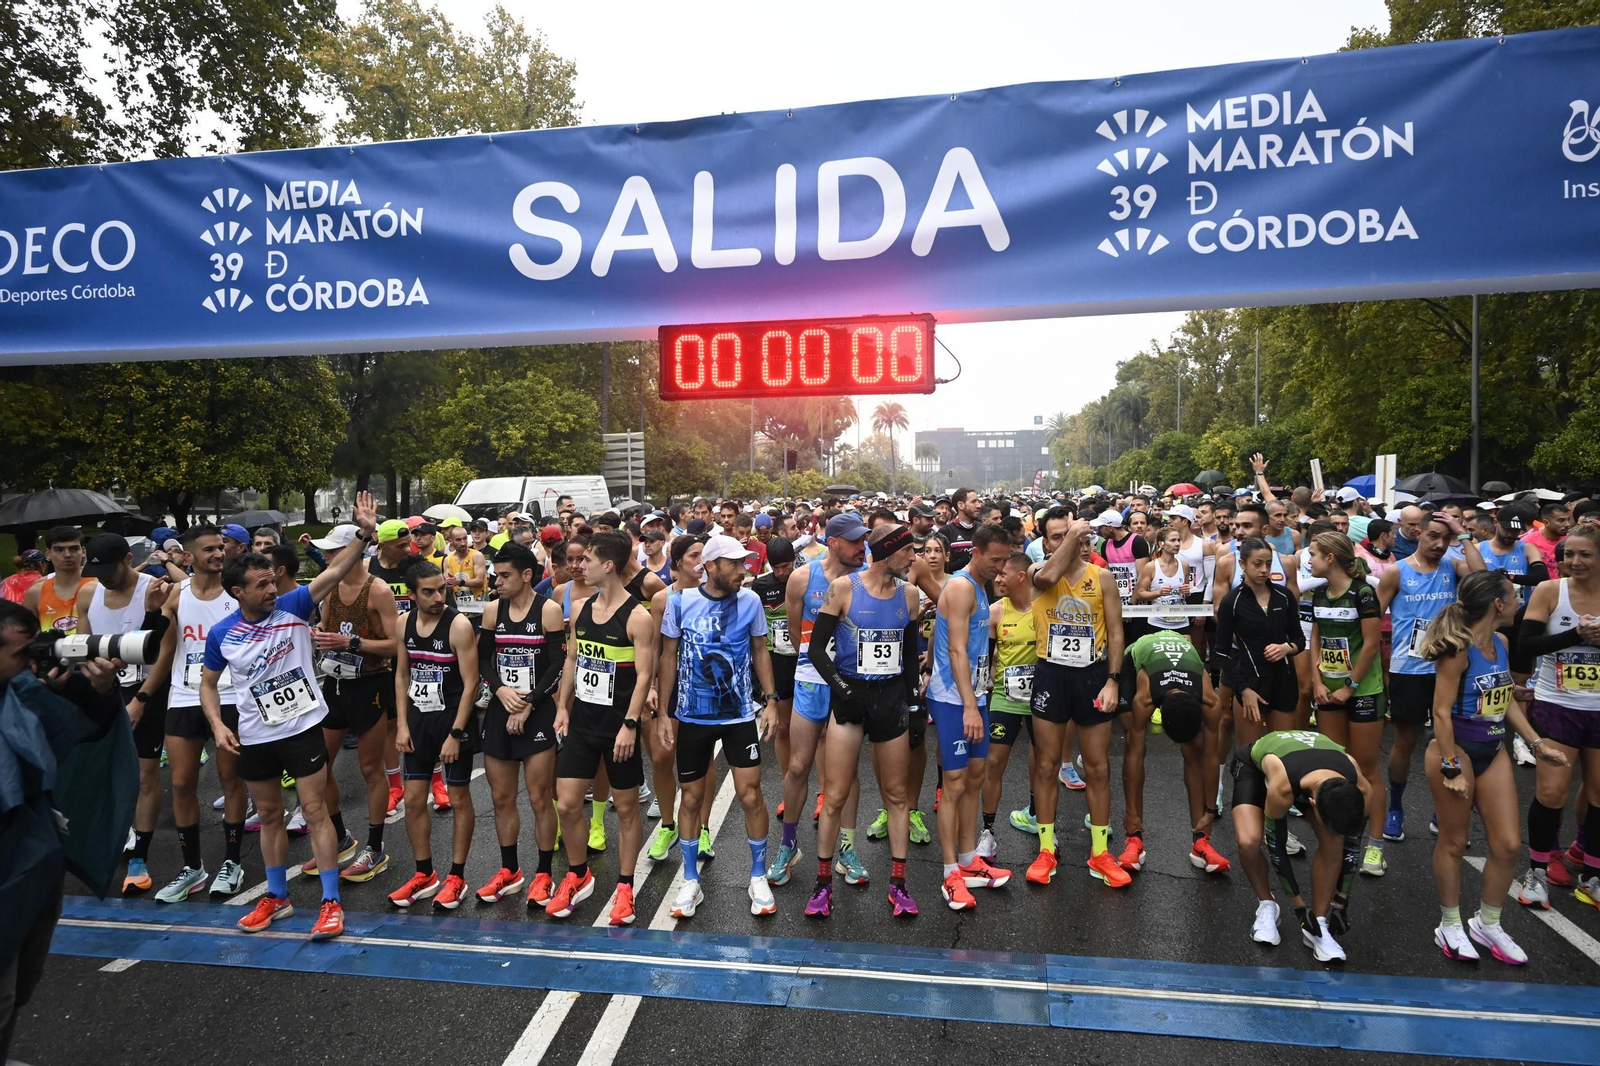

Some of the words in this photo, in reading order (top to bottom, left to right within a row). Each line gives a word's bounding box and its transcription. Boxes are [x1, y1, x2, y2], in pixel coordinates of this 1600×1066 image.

[1186, 88, 1327, 133] MEDIA
[1187, 117, 1414, 174] MARATÓN
[265, 179, 361, 211] MEDIA
[1108, 184, 1157, 220] 39
[266, 202, 423, 245] MARATÓN
[509, 147, 1010, 280] SALIDA
[1187, 205, 1418, 254] CÓRDOBA
[209, 252, 243, 282] 39
[0, 287, 68, 306] Deportes
[71, 283, 136, 300] Córdoba
[266, 276, 429, 312] CÓRDOBA
[578, 642, 606, 659] ASM
[874, 644, 892, 658] 53
[1062, 638, 1080, 652] 23
[334, 664, 342, 676] 4
[506, 669, 518, 683] 25
[583, 672, 598, 688] 40
[1564, 666, 1600, 681] 163
[273, 687, 296, 706] 60
[414, 684, 428, 698] 24
[1485, 687, 1512, 706] 1917
